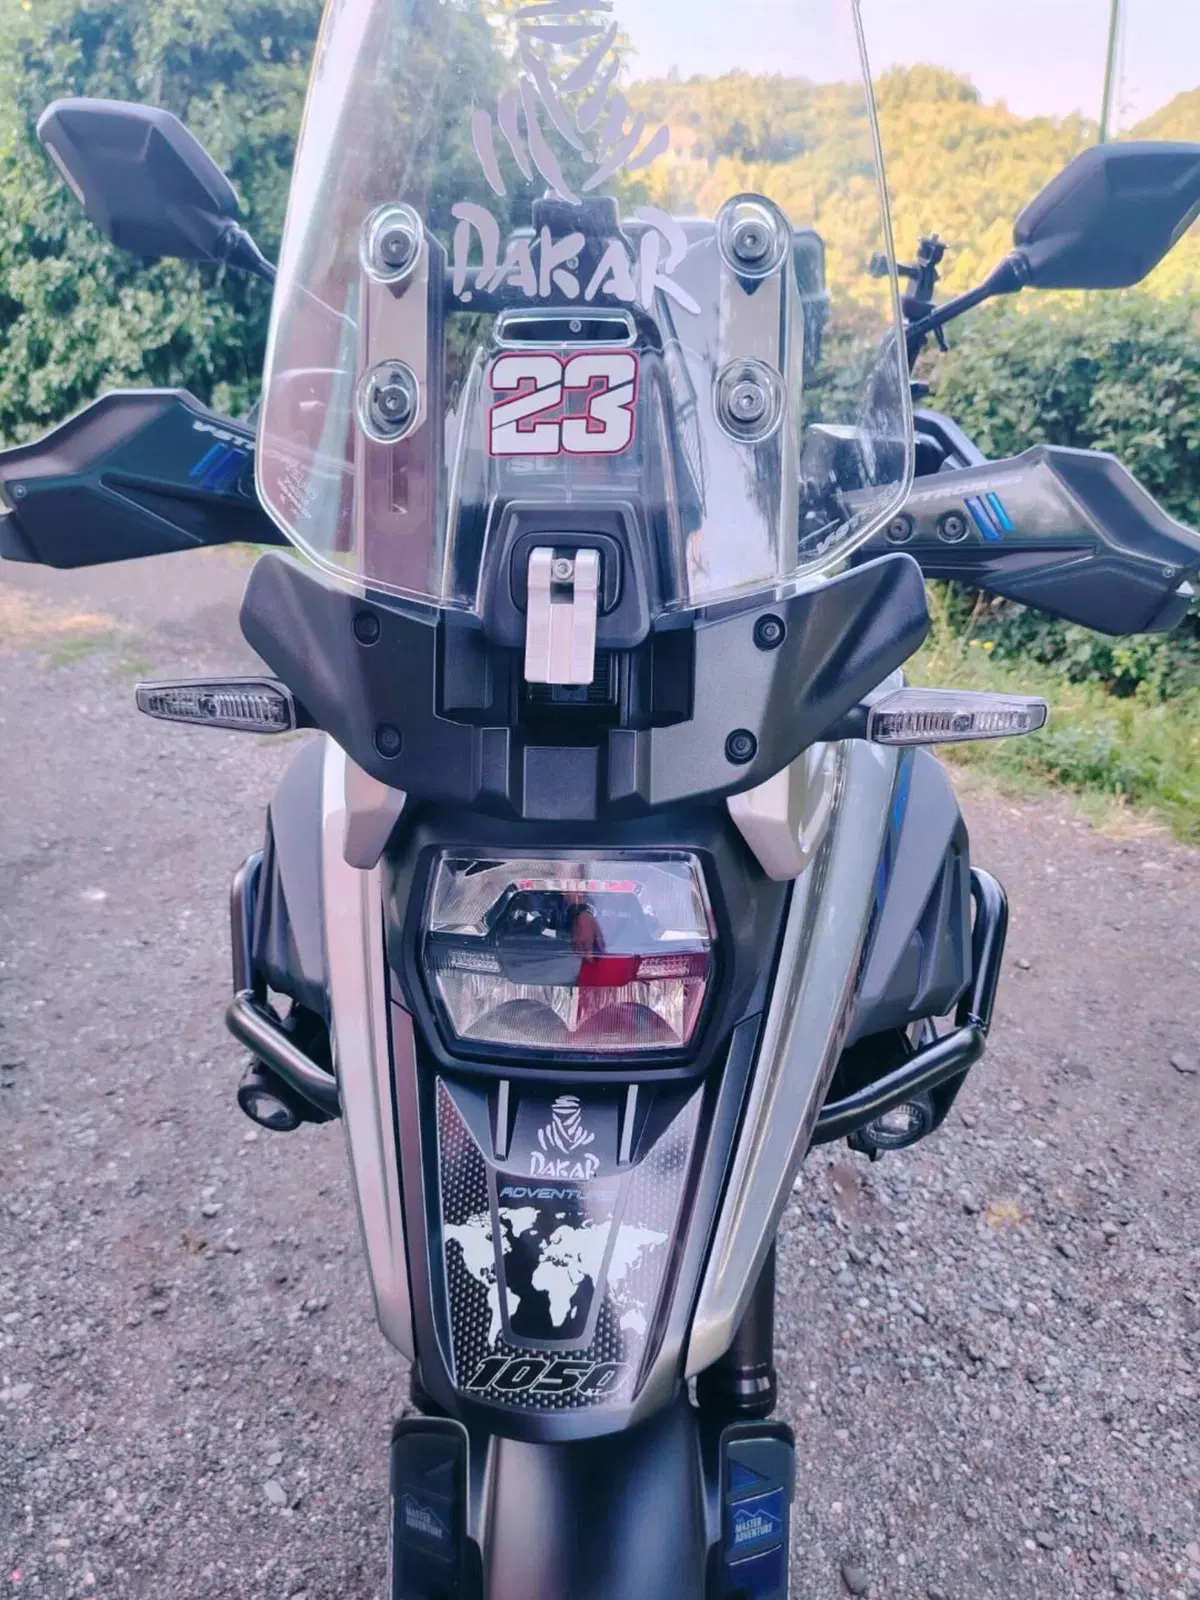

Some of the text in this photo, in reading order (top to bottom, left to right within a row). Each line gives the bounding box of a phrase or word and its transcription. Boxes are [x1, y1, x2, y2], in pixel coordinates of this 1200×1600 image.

[451, 202, 702, 314] DAKAR
[488, 350, 640, 458] 23
[500, 1187, 615, 1200] ADVENTUE
[466, 1356, 634, 1396] 1050
[735, 1516, 762, 1533] MASTER
[735, 1523, 773, 1544] ADVENTURE
